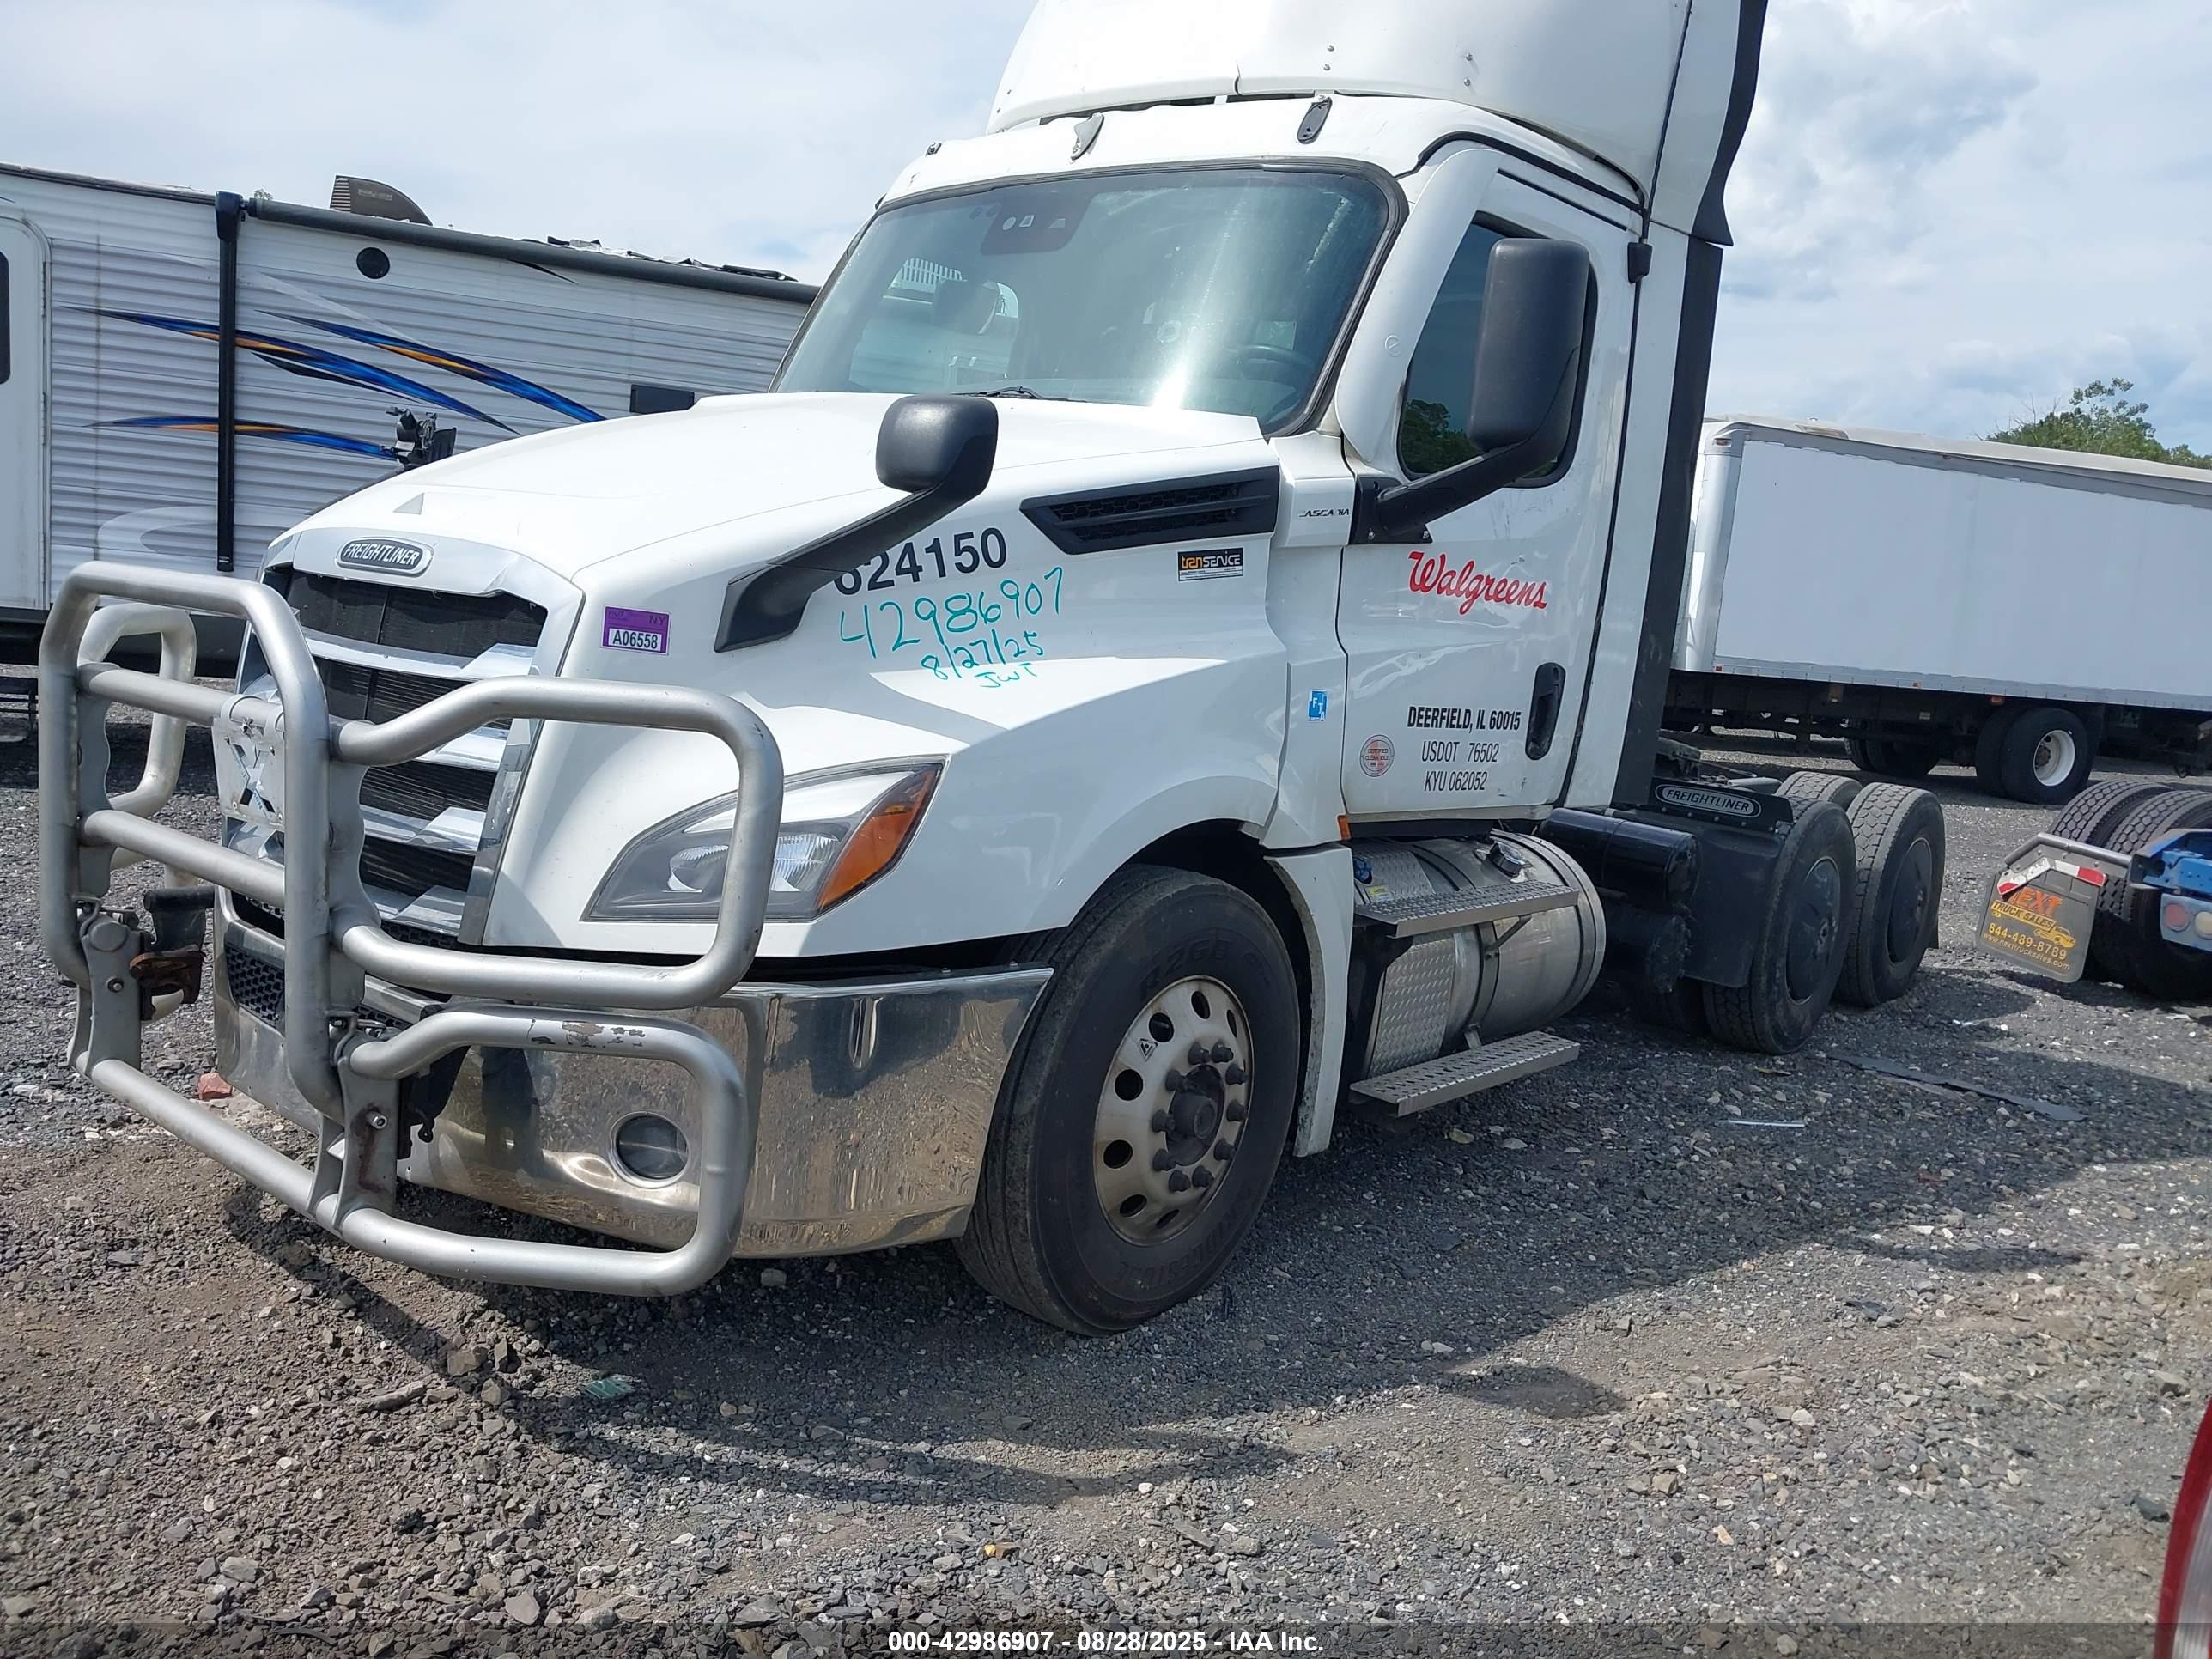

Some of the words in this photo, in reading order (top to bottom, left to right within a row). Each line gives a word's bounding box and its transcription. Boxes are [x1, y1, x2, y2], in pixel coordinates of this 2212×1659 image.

[343, 543, 420, 566] FREIGHTLINER
[1408, 551, 1547, 615] Walgreens
[648, 615, 665, 625] NY
[840, 566, 1064, 659] 42986907
[612, 629, 659, 649] A06558
[921, 629, 1044, 680] 8/27/25
[1407, 706, 1474, 733] DEERFIELD,
[1476, 709, 1486, 730] IL
[1489, 710, 1522, 730] 60015
[1421, 740, 1460, 762] USDOT
[1468, 743, 1499, 763] 76502
[1424, 770, 1448, 792] KYU
[1449, 771, 1488, 791] 062052
[1666, 789, 1751, 812] FREIGHTLINER
[1992, 902, 2021, 919] TRUCK
[2022, 912, 2054, 928] SALES
[1989, 922, 2067, 960] 844-489-8789
